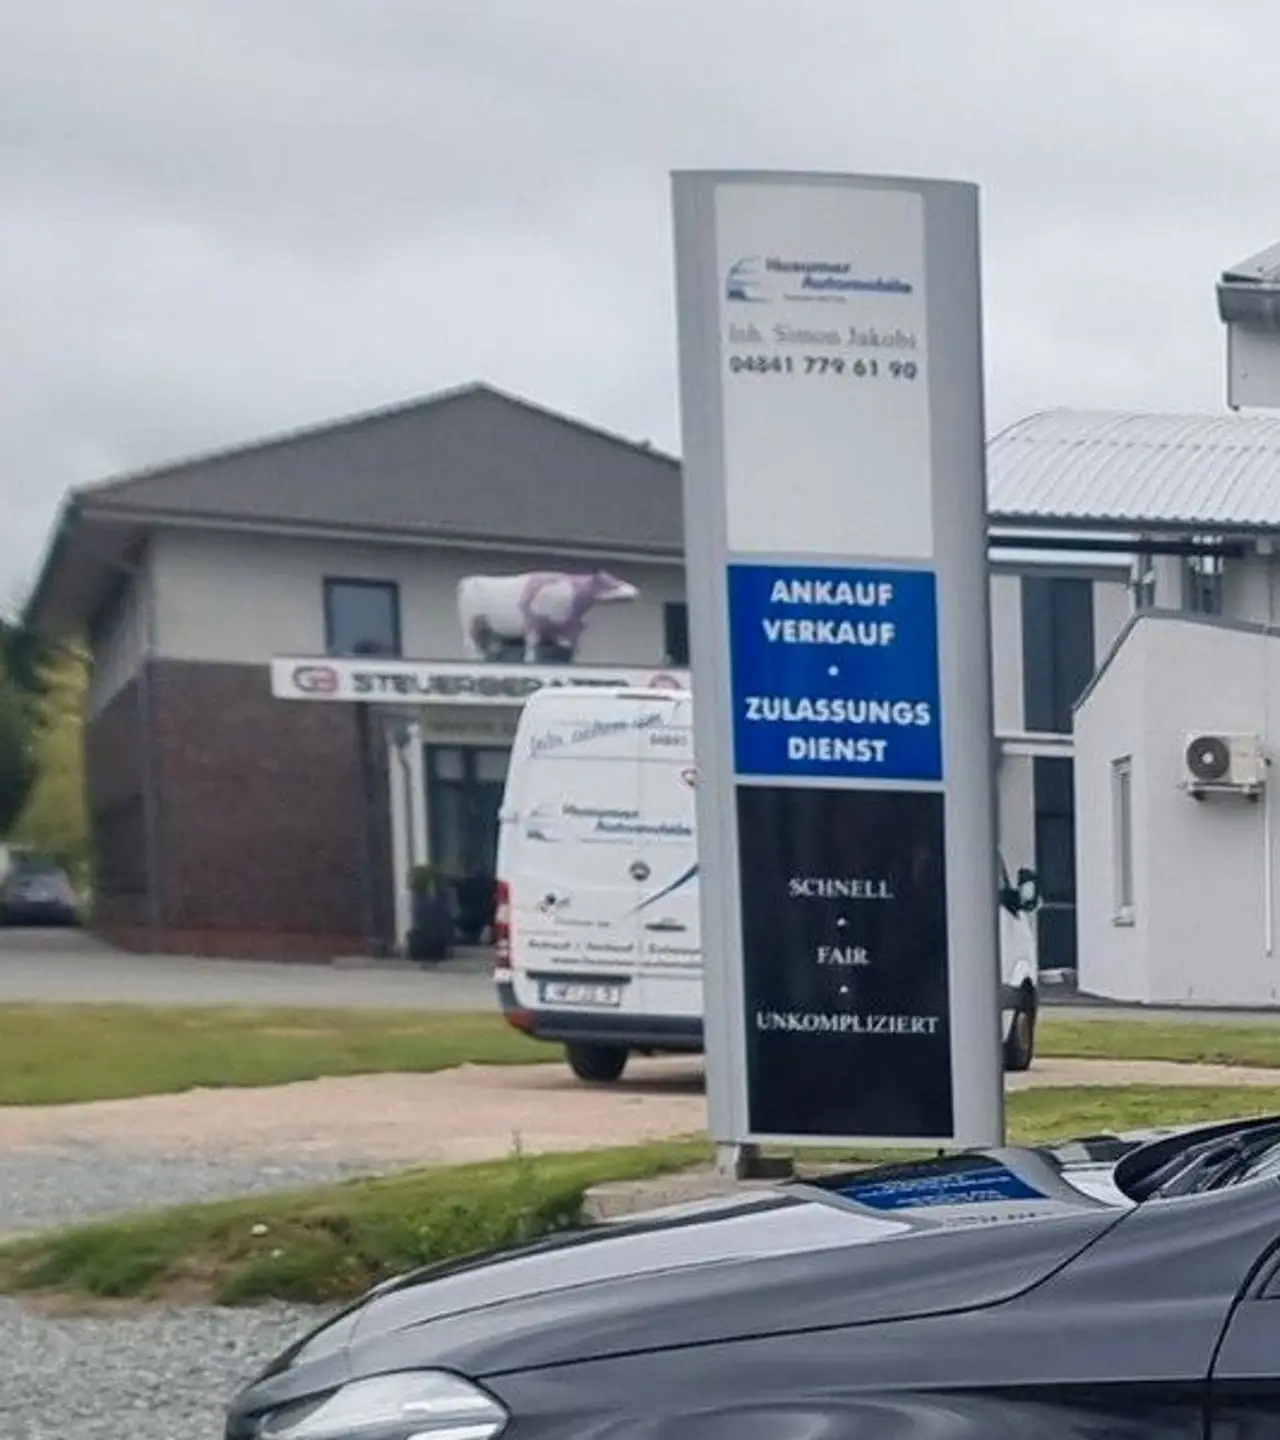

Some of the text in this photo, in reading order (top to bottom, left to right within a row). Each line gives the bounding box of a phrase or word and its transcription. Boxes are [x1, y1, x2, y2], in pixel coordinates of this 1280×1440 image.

[804, 355, 845, 374] 779
[853, 358, 878, 378] 61
[889, 360, 918, 381] 90
[770, 579, 893, 607] ANKAUF
[762, 618, 895, 646] VERKAUF
[745, 696, 932, 726] ZULASSUNGS
[787, 737, 888, 762] DIENST
[788, 878, 894, 899] SCHNELL
[816, 946, 870, 965] FAIR
[755, 1011, 940, 1035] UNKOMPLIZIERT
